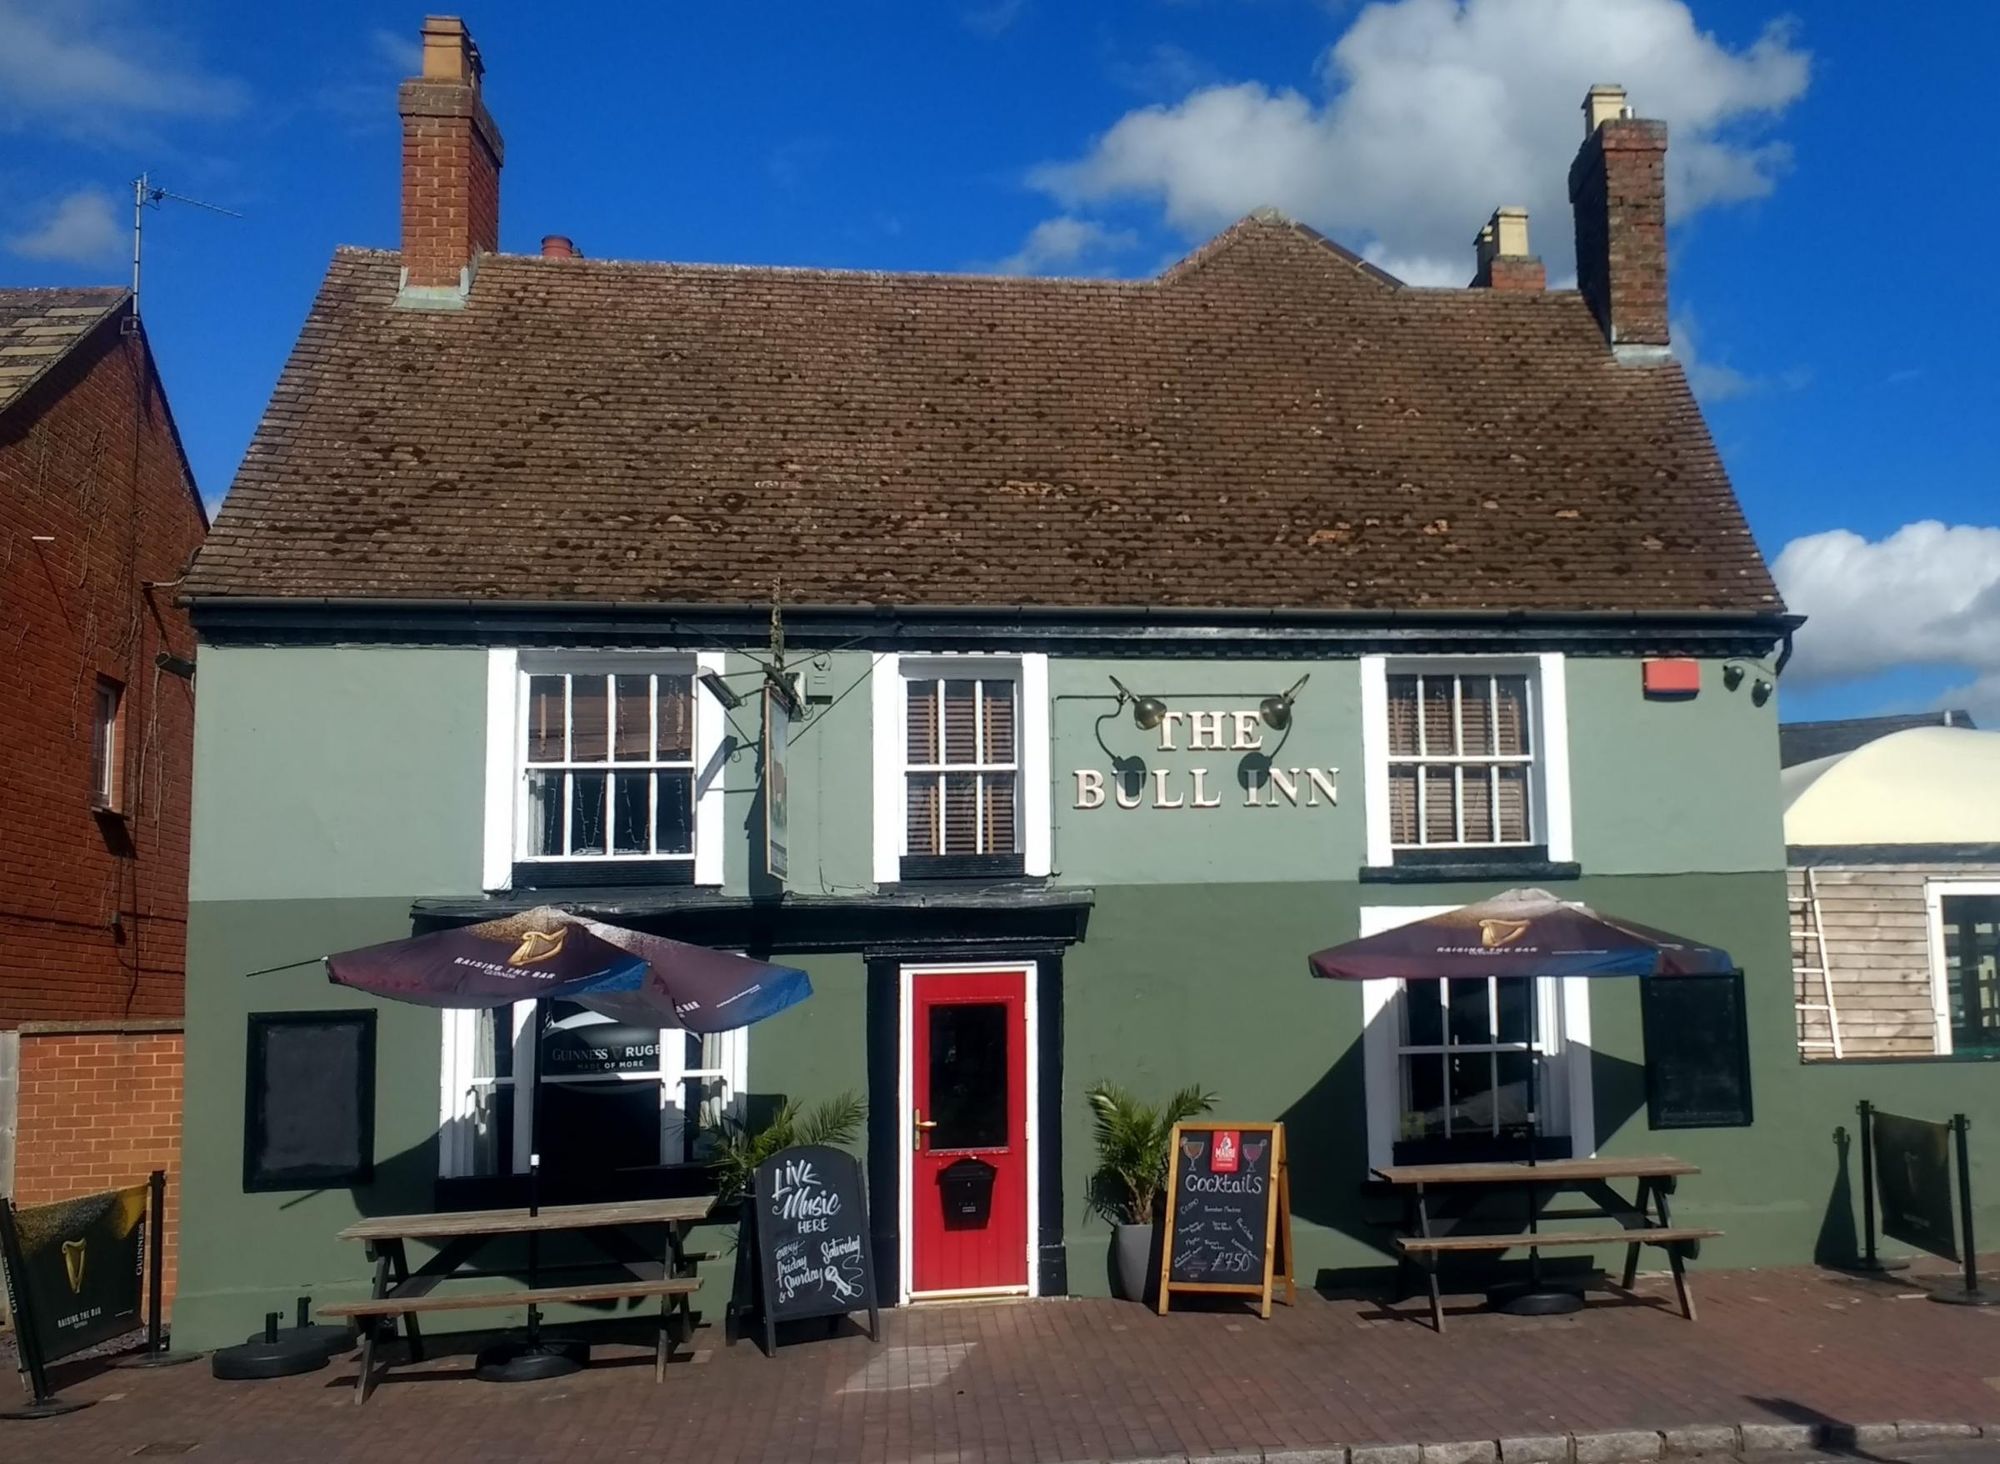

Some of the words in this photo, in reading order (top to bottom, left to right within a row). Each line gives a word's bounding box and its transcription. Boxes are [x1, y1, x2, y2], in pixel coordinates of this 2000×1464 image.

[1157, 710, 1263, 751] THE
[1072, 768, 1222, 810] BULL
[1242, 767, 1340, 808] INN
[453, 956, 503, 971] RAISING
[507, 967, 531, 977] THE
[531, 971, 556, 980] BAR
[552, 1047, 609, 1061] GUINNESS
[619, 1060, 644, 1068] MORE
[772, 1186, 841, 1219] Music
[798, 1217, 830, 1234] HERE
[820, 1235, 860, 1265] Saturday
[783, 1267, 824, 1298] Sunday
